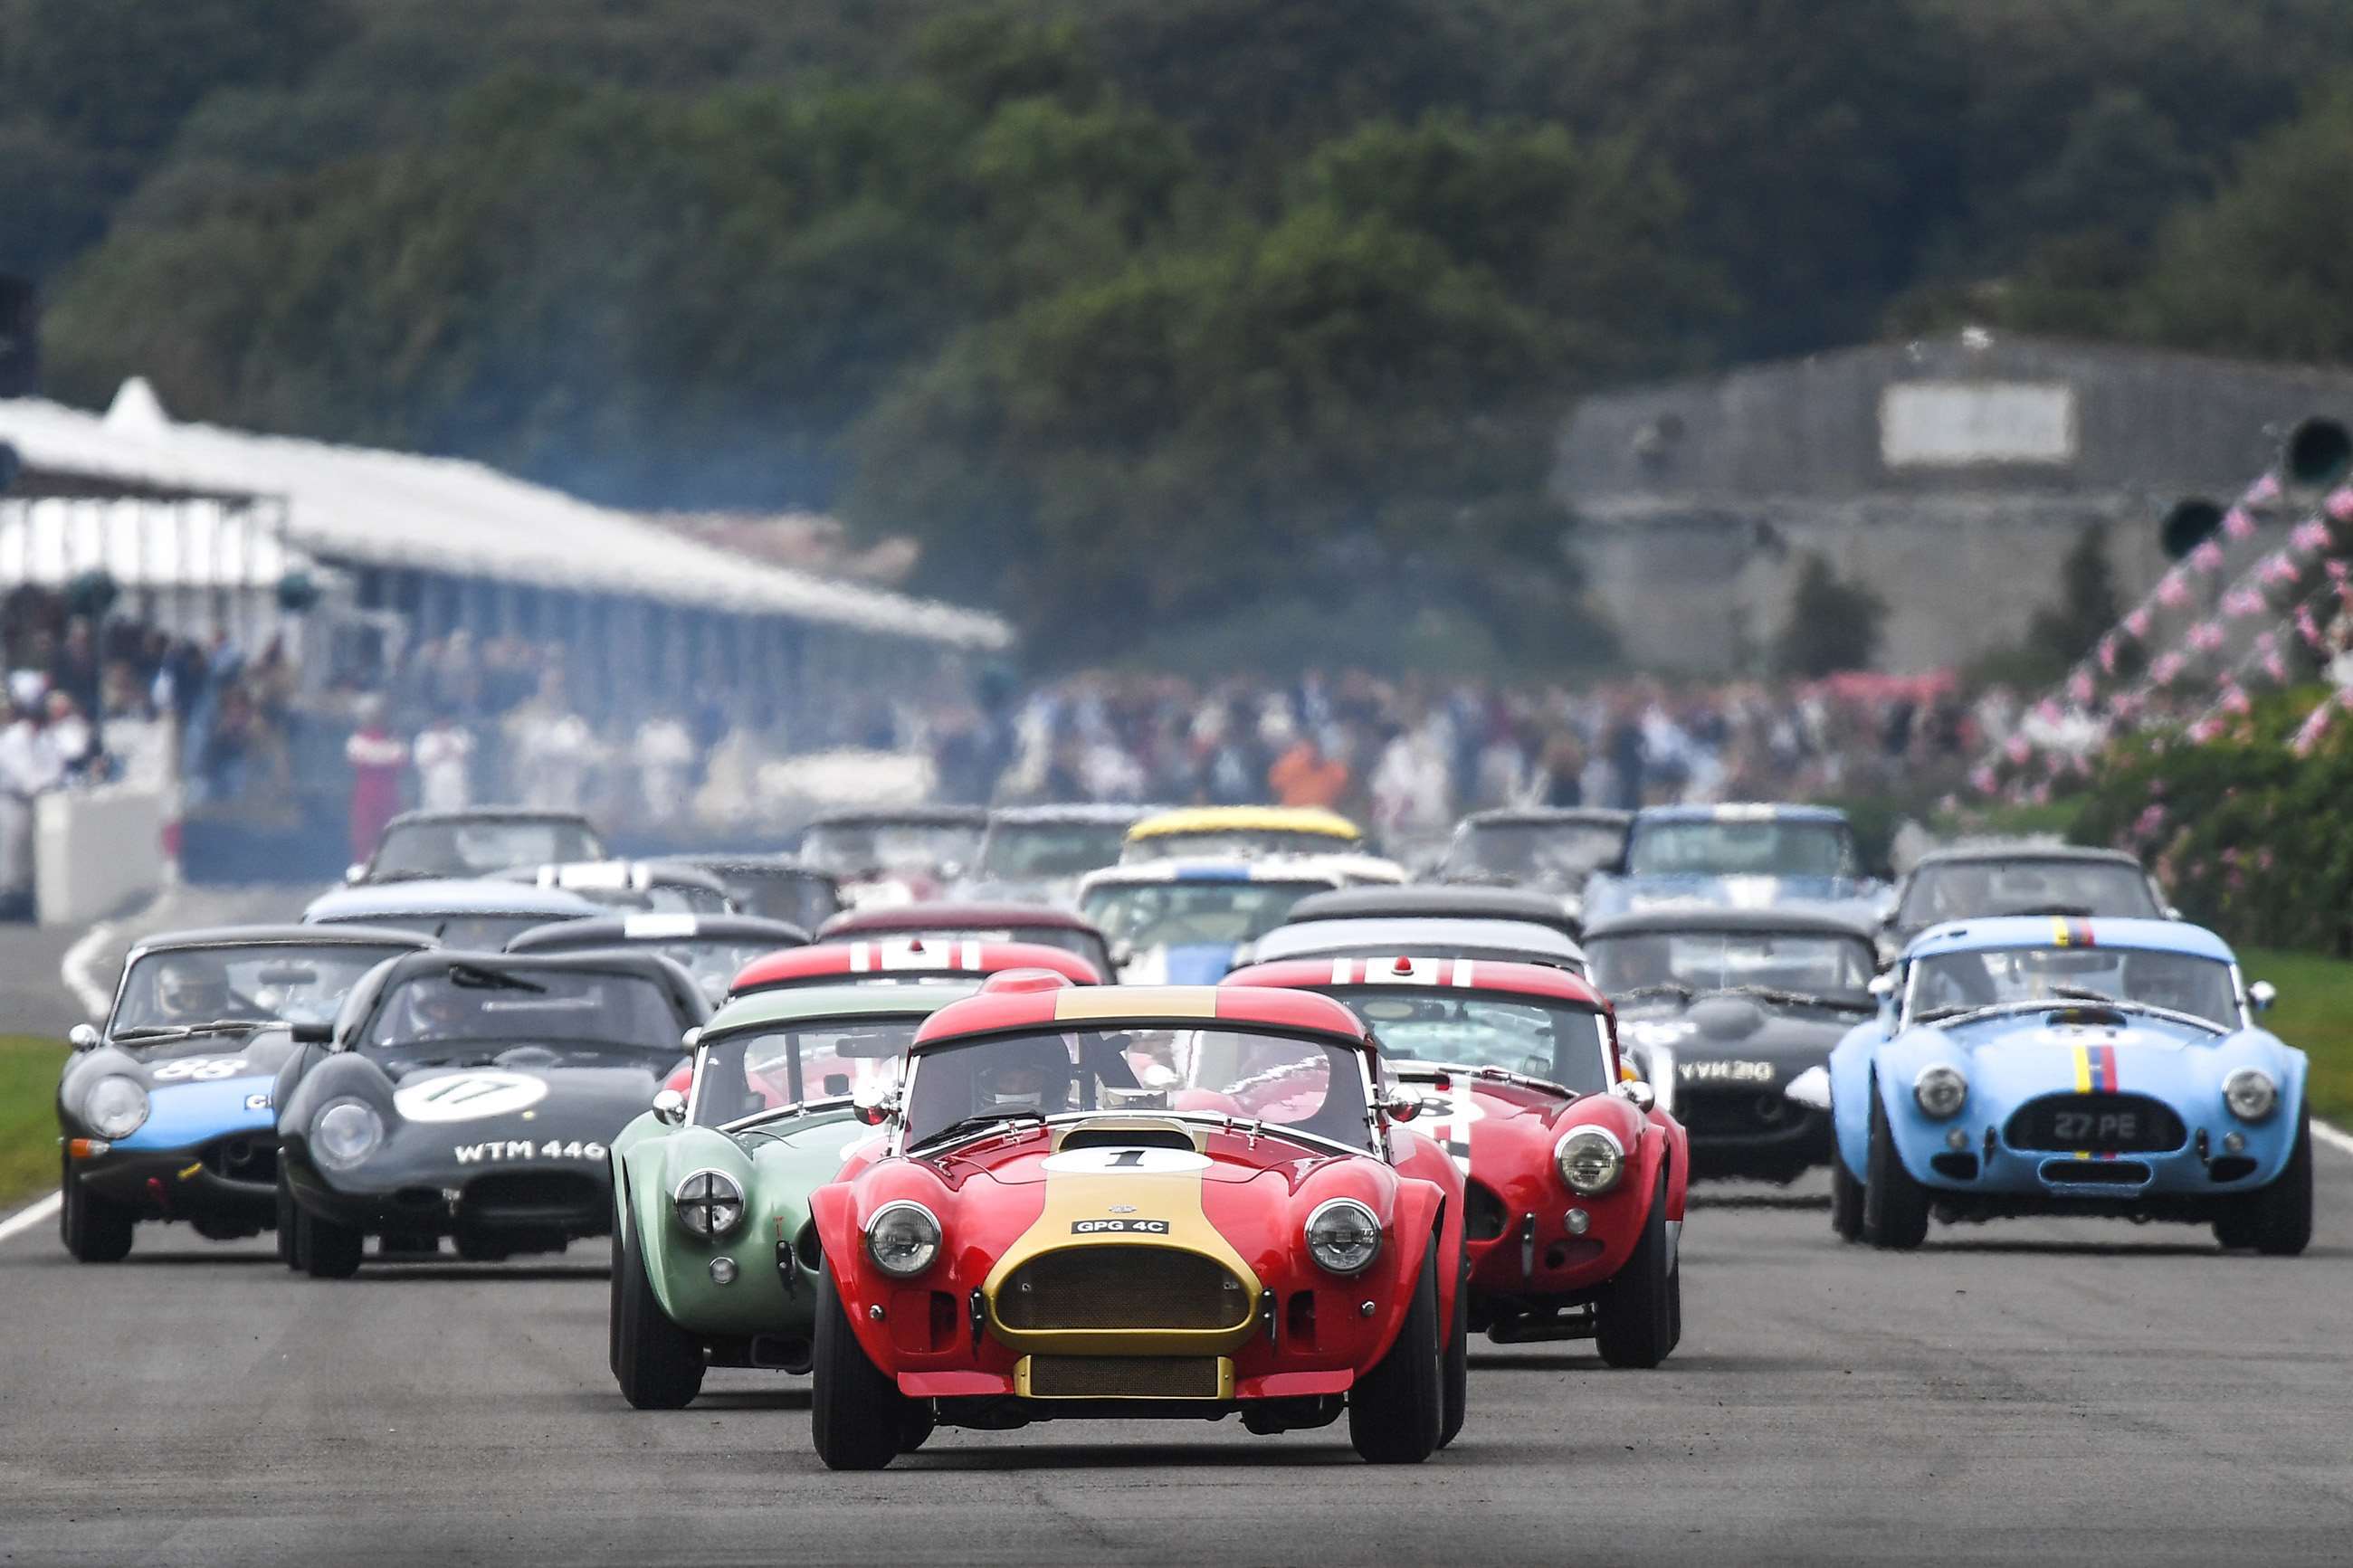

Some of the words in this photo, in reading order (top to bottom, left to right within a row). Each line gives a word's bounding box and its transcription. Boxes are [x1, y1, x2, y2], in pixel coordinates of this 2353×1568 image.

[2054, 1111, 2093, 1138] 27
[2099, 1112, 2137, 1138] PE
[454, 1139, 535, 1164] WTM
[540, 1138, 607, 1161] 446
[1104, 1150, 1147, 1167] 1
[1076, 1221, 1125, 1232] GPG
[1132, 1221, 1165, 1232] 4C
